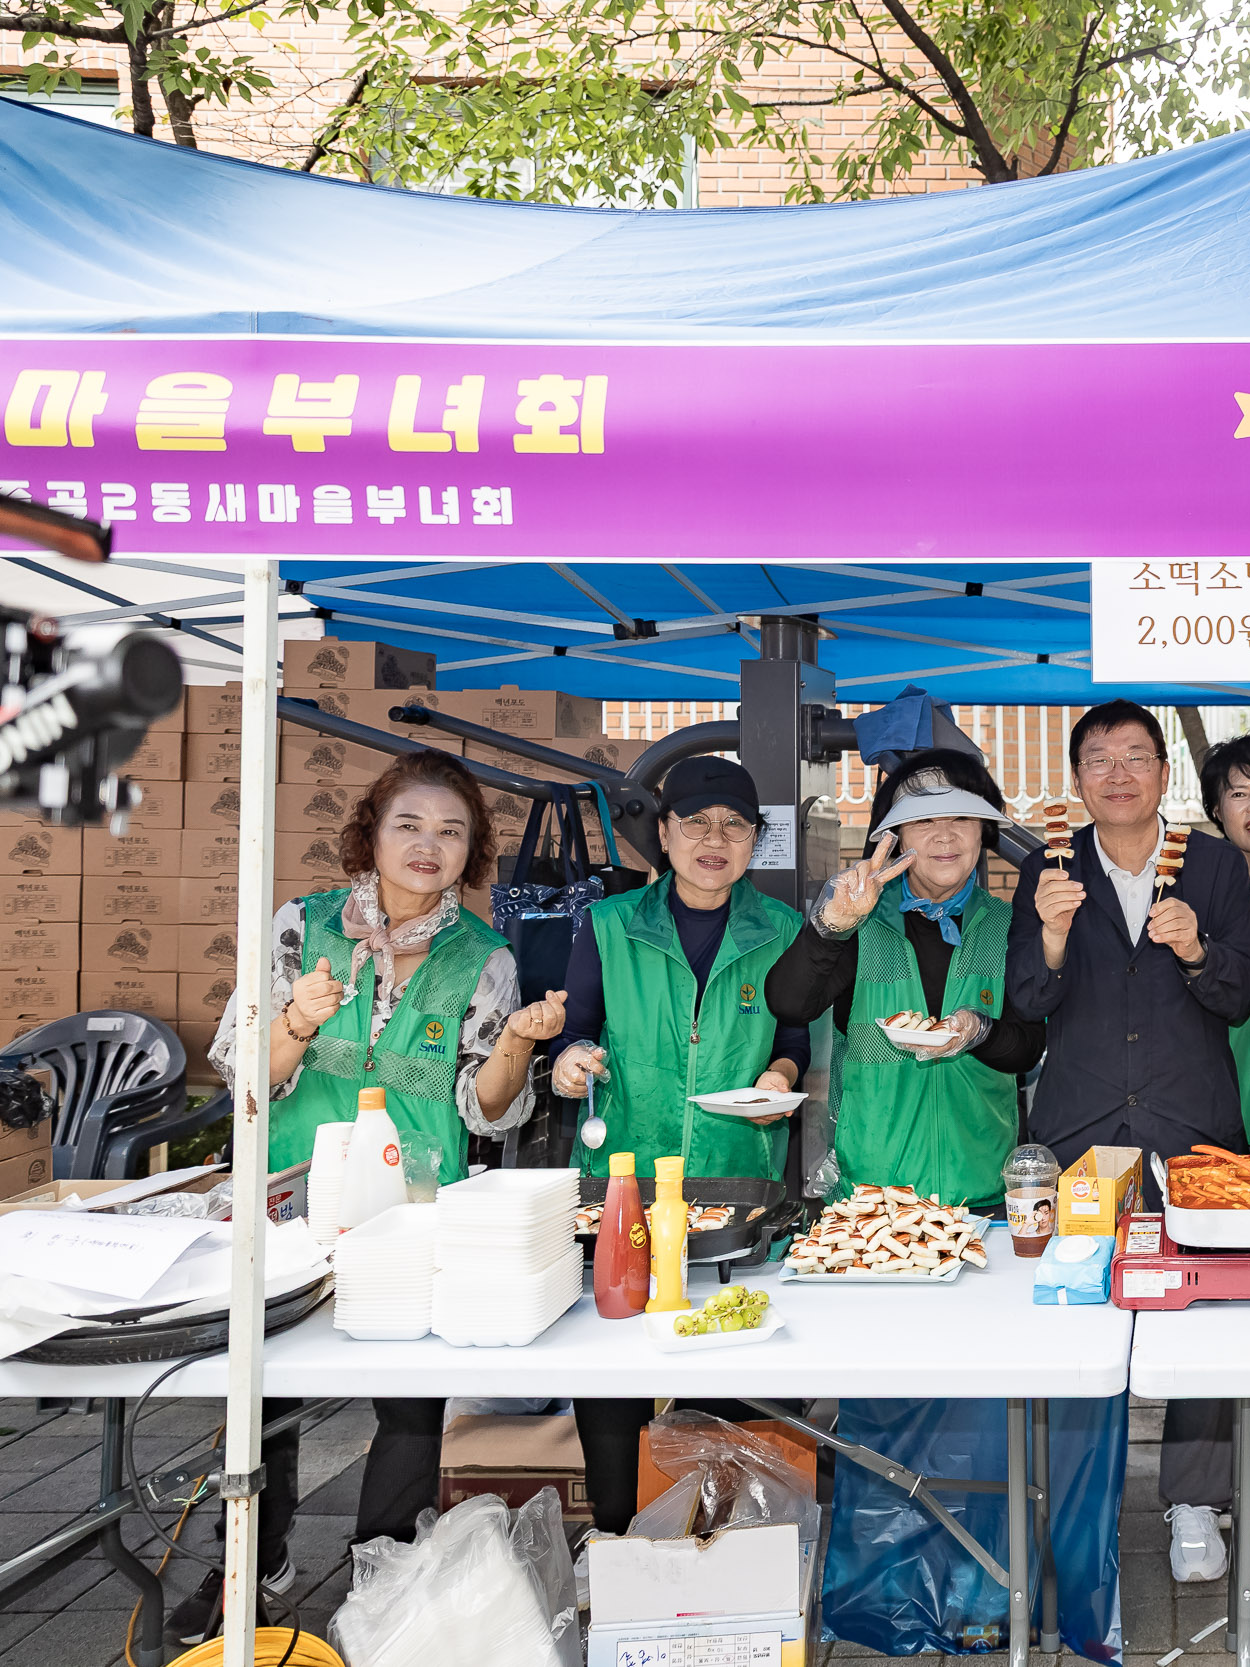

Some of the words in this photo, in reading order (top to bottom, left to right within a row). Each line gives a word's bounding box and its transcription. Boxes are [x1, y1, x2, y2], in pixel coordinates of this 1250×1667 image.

[4, 369, 608, 454] 마을부녀회
[220, 694, 242, 702] 백년포
[219, 743, 240, 751] 백년포
[215, 837, 239, 845] 백년포
[214, 885, 238, 893] 백년포
[739, 1005, 760, 1014] SMU
[419, 1041, 446, 1054] SMU
